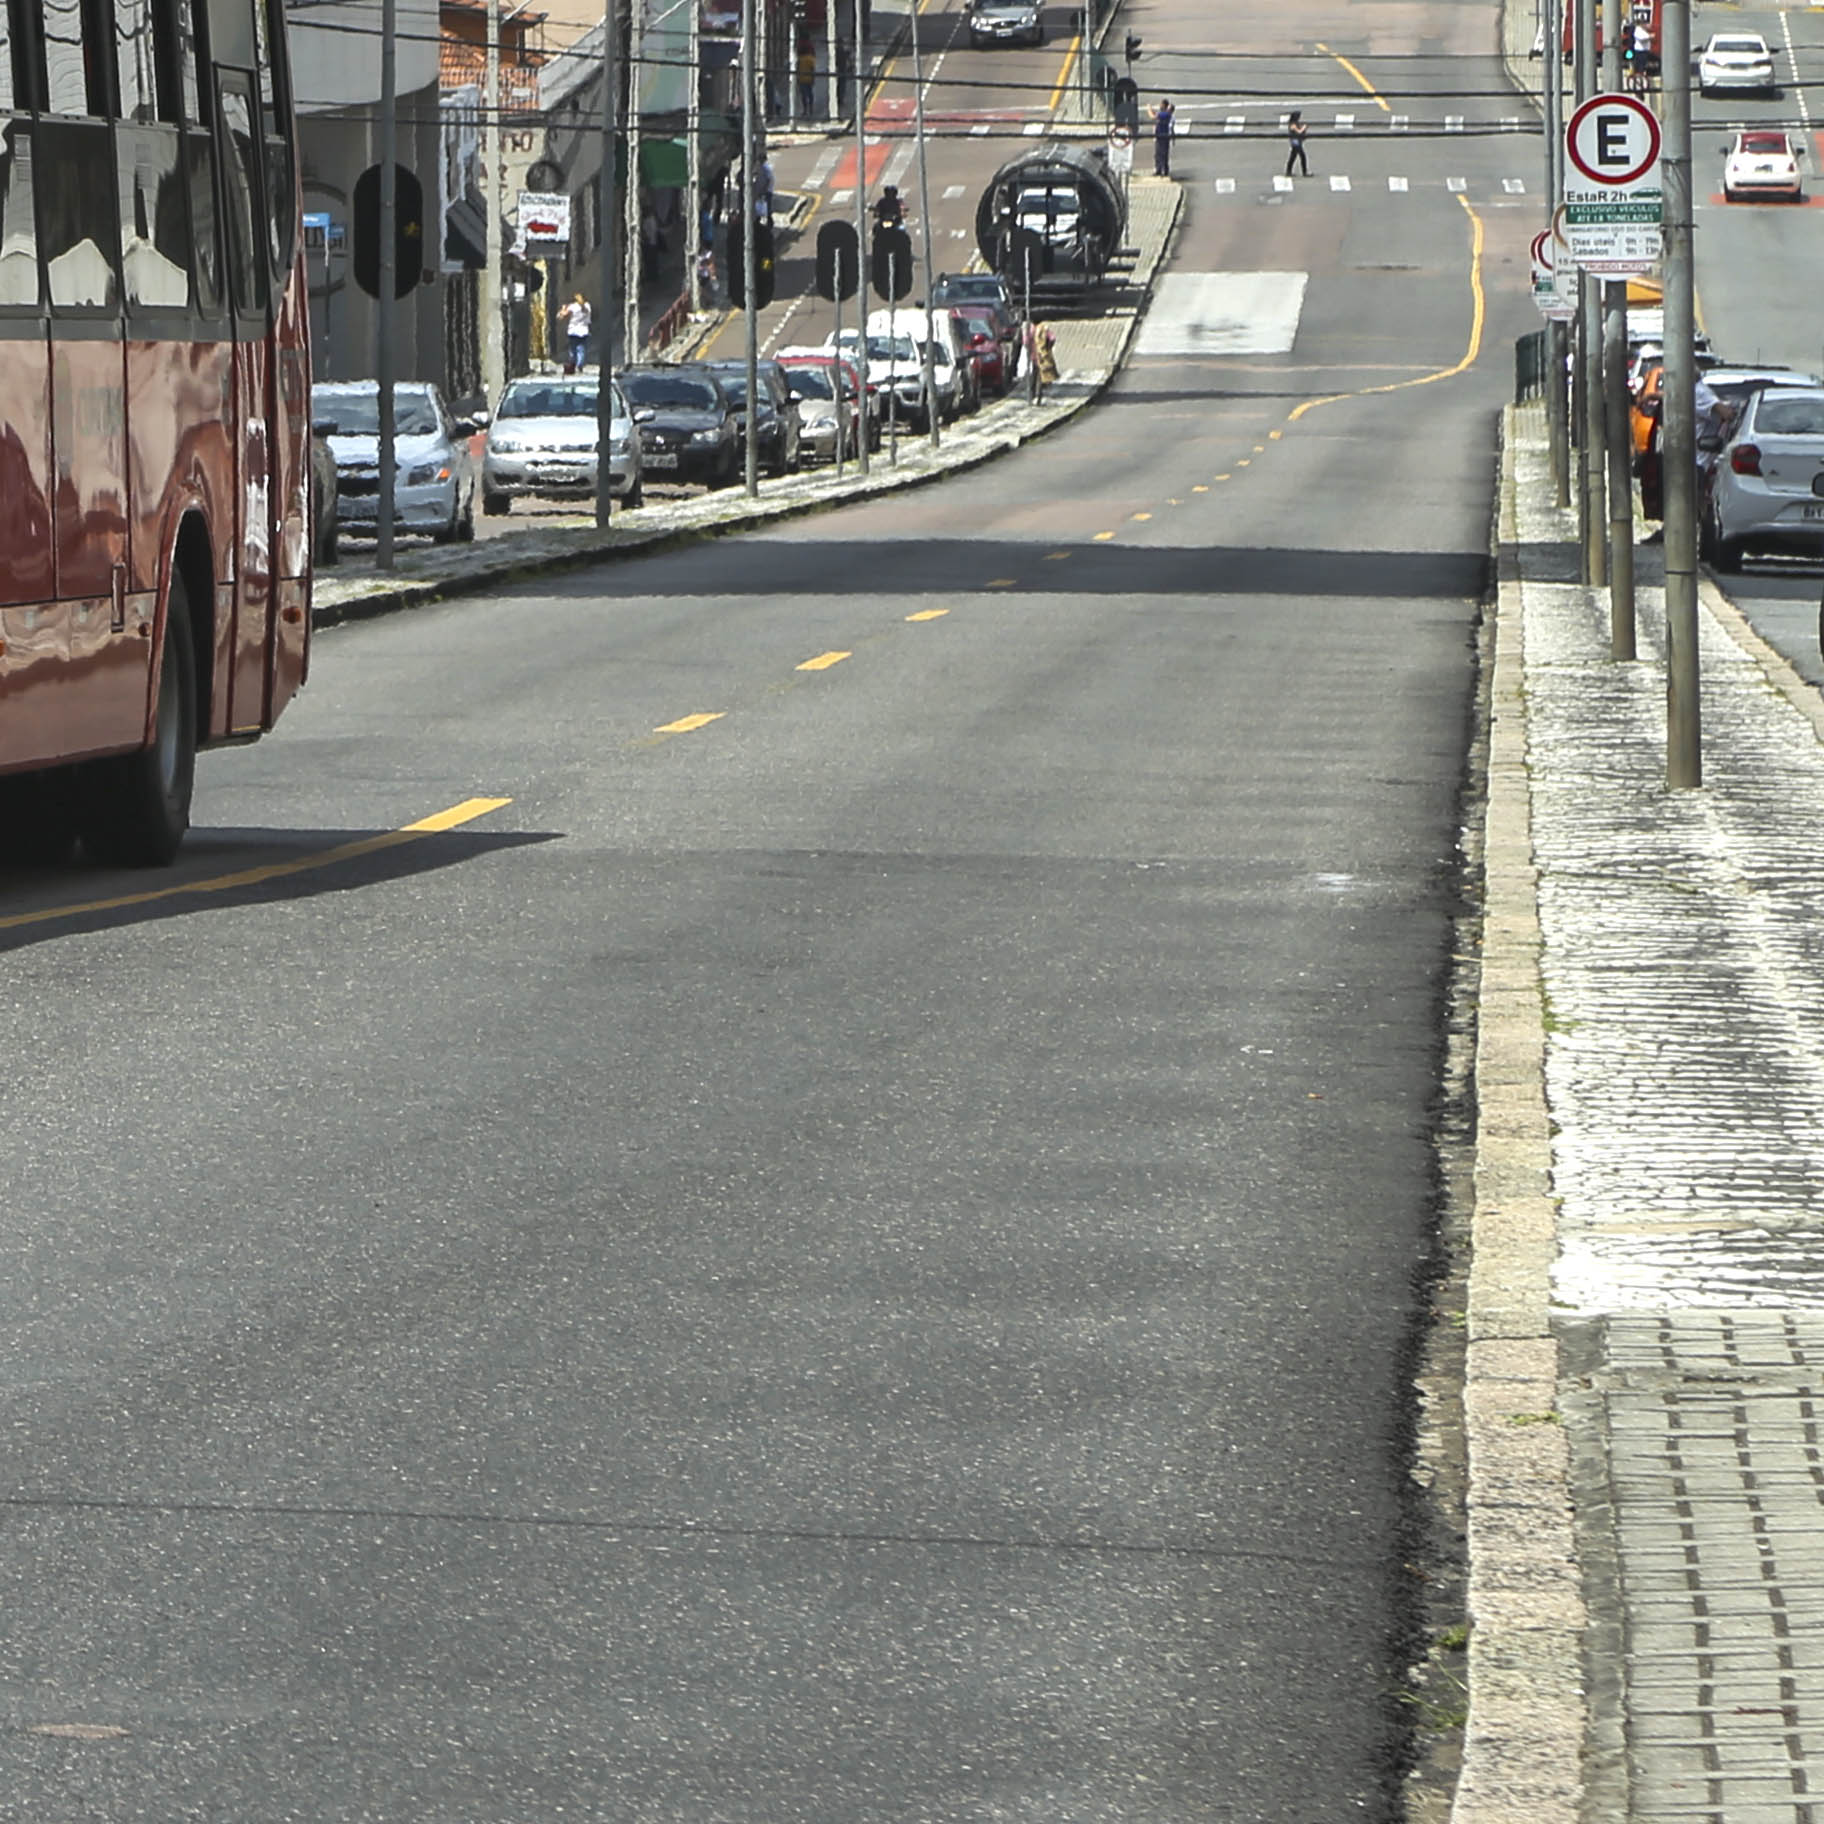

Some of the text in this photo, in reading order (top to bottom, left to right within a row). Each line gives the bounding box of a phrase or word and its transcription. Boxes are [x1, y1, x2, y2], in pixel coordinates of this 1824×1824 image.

[1597, 115, 1631, 166] E
[1567, 191, 1628, 203] EstaR 2h
[1570, 205, 1617, 213] EXCLUSIVO
[1572, 238, 1591, 246] Dias
